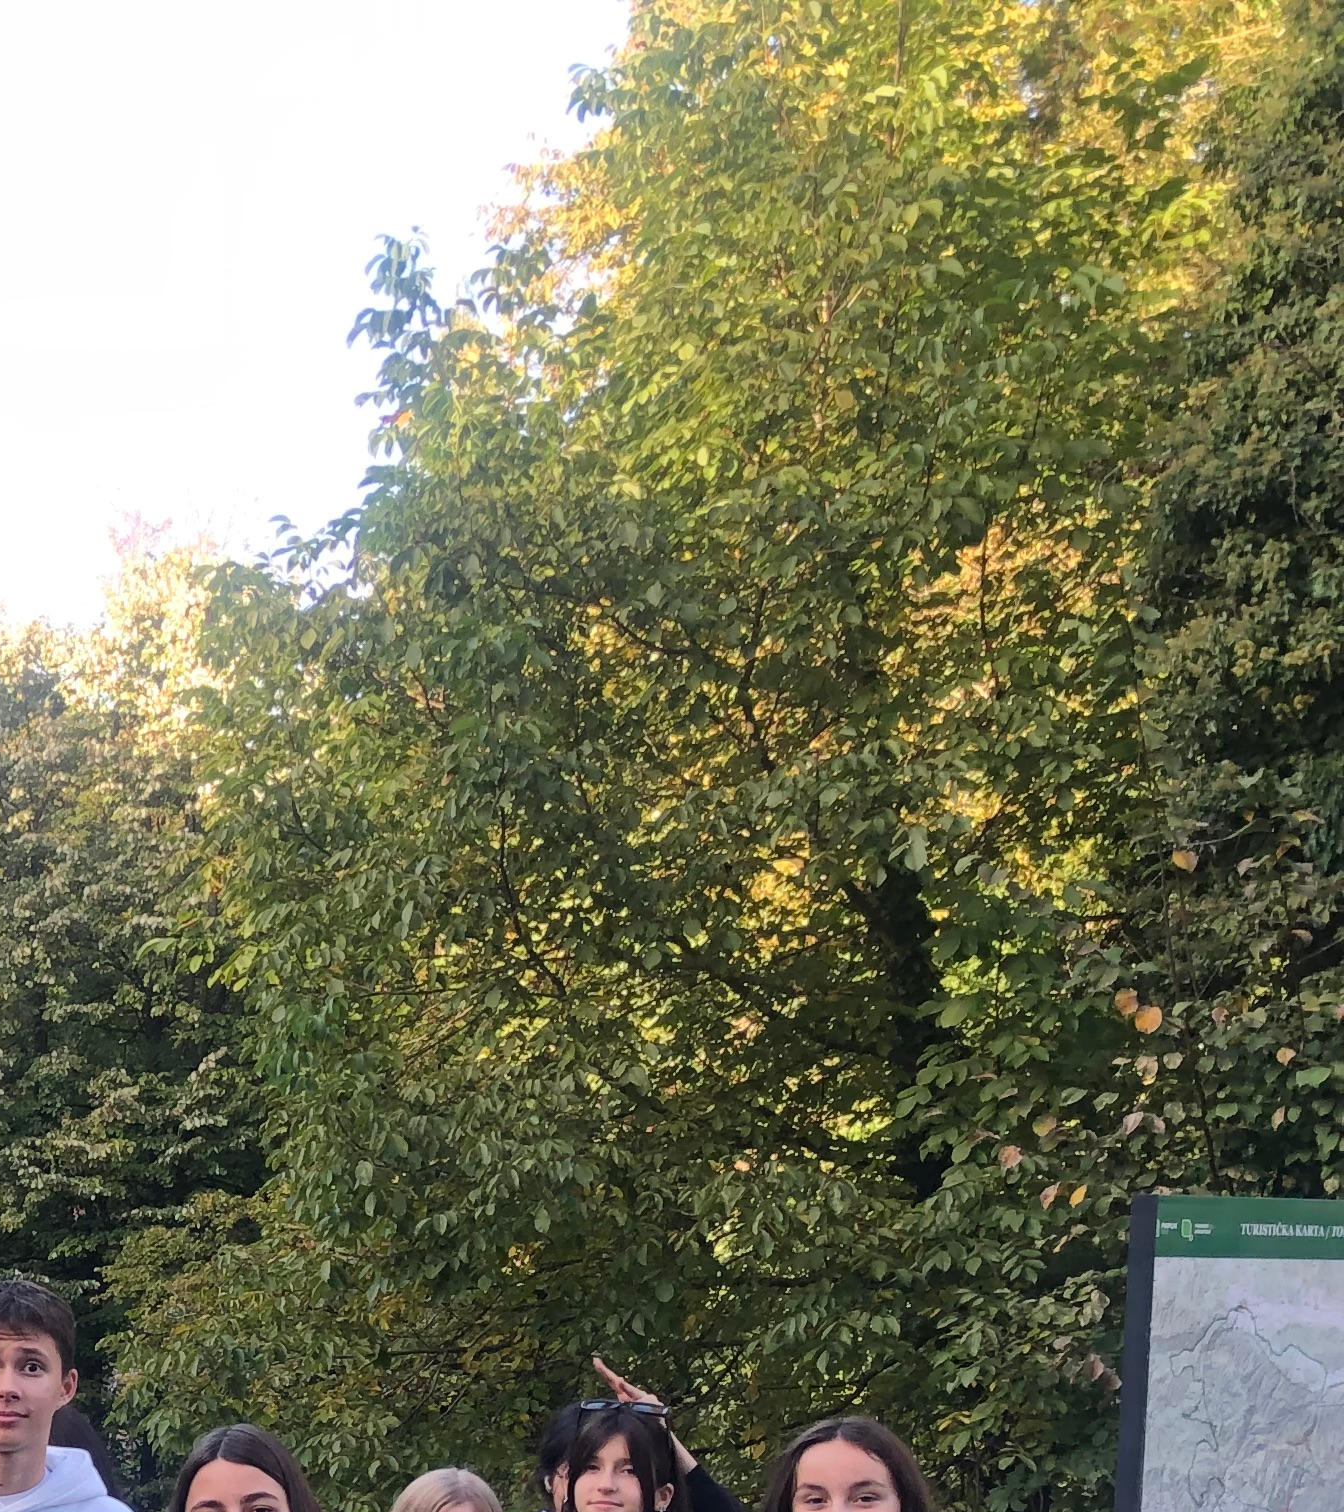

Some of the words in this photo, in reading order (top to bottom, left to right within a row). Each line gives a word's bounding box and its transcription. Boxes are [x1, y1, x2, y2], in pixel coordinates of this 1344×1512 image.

[1240, 1222, 1293, 1237] TURISTIČKA
[1296, 1224, 1324, 1236] KARTA
[1332, 1226, 1344, 1238] TO
